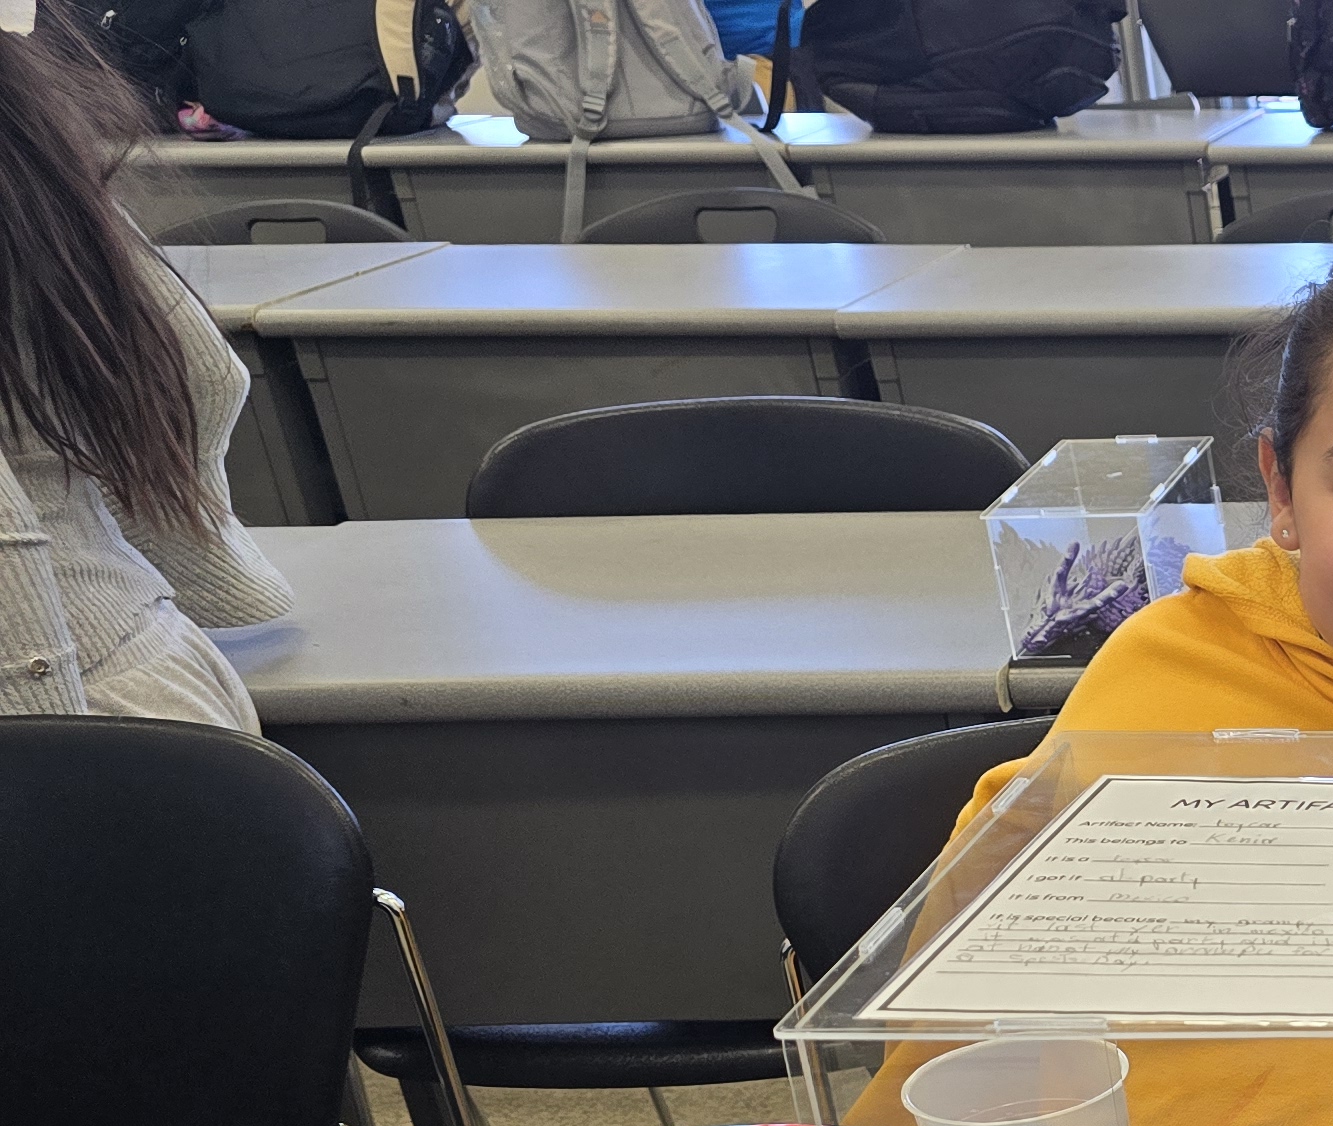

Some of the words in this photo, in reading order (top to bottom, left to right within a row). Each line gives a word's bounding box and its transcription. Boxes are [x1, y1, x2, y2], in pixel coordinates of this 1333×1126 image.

[1170, 798, 1225, 810] MY
[1077, 820, 1143, 828] Artifact
[1099, 837, 1166, 846] belongs
[1034, 875, 1067, 883] got
[1139, 871, 1199, 890] party
[1008, 893, 1023, 901] It
[1024, 893, 1040, 901] is
[1042, 893, 1085, 901] from
[1023, 914, 1089, 922] special
[1091, 914, 1168, 923] because
